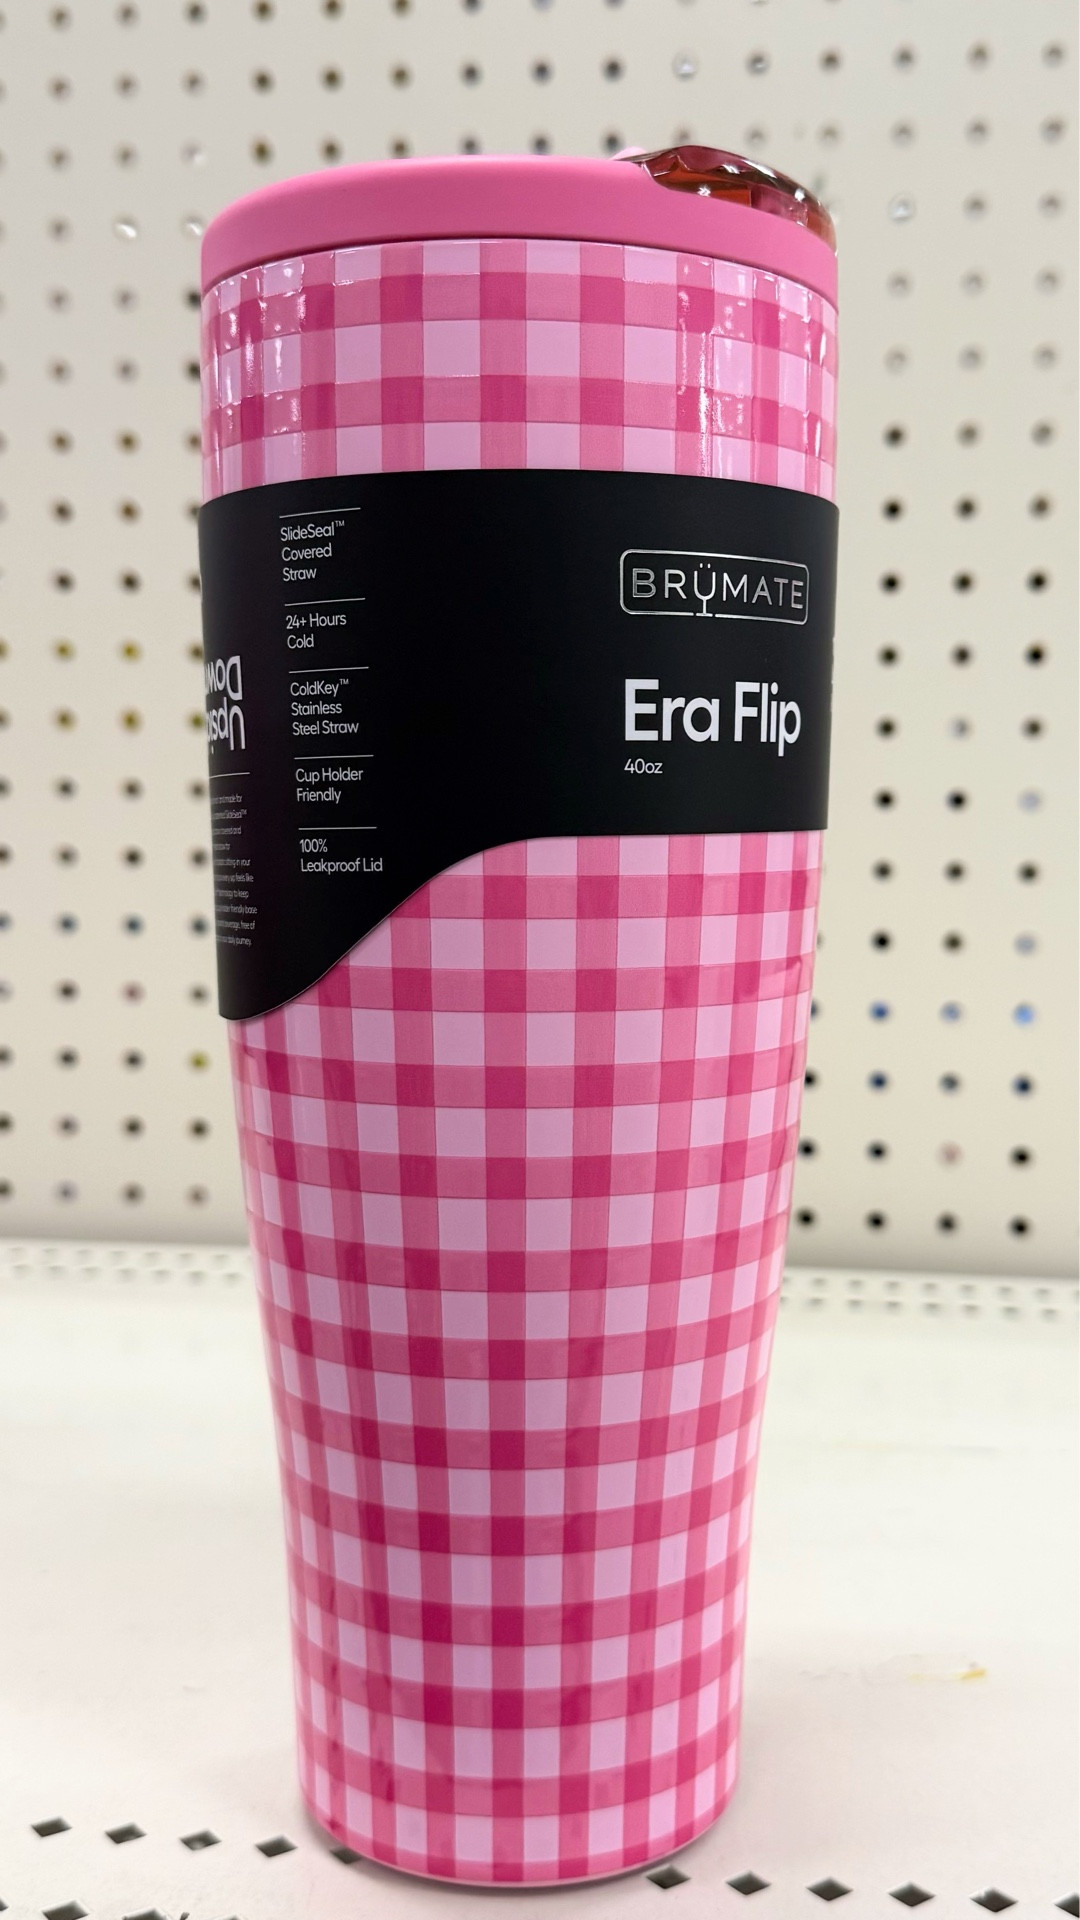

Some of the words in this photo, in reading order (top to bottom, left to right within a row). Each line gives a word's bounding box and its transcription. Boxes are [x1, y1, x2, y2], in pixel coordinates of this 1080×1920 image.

[281, 542, 332, 562] Covered
[282, 567, 317, 582] Straw
[632, 563, 804, 617] BRÜMATE
[285, 615, 307, 629] 24+
[309, 613, 347, 627] Hours
[287, 634, 315, 649] Cold
[291, 701, 343, 716] Stainless
[625, 678, 720, 742] Era
[734, 681, 801, 757] Flip
[292, 721, 320, 736] Steel
[322, 720, 359, 735] Straw
[624, 758, 663, 774] 40oz
[295, 768, 320, 785] Cup
[322, 767, 364, 782] Holder
[296, 787, 341, 804] Friendly
[300, 838, 328, 853] 100%
[301, 858, 360, 875] Leakproof
[363, 857, 383, 872] Lid
